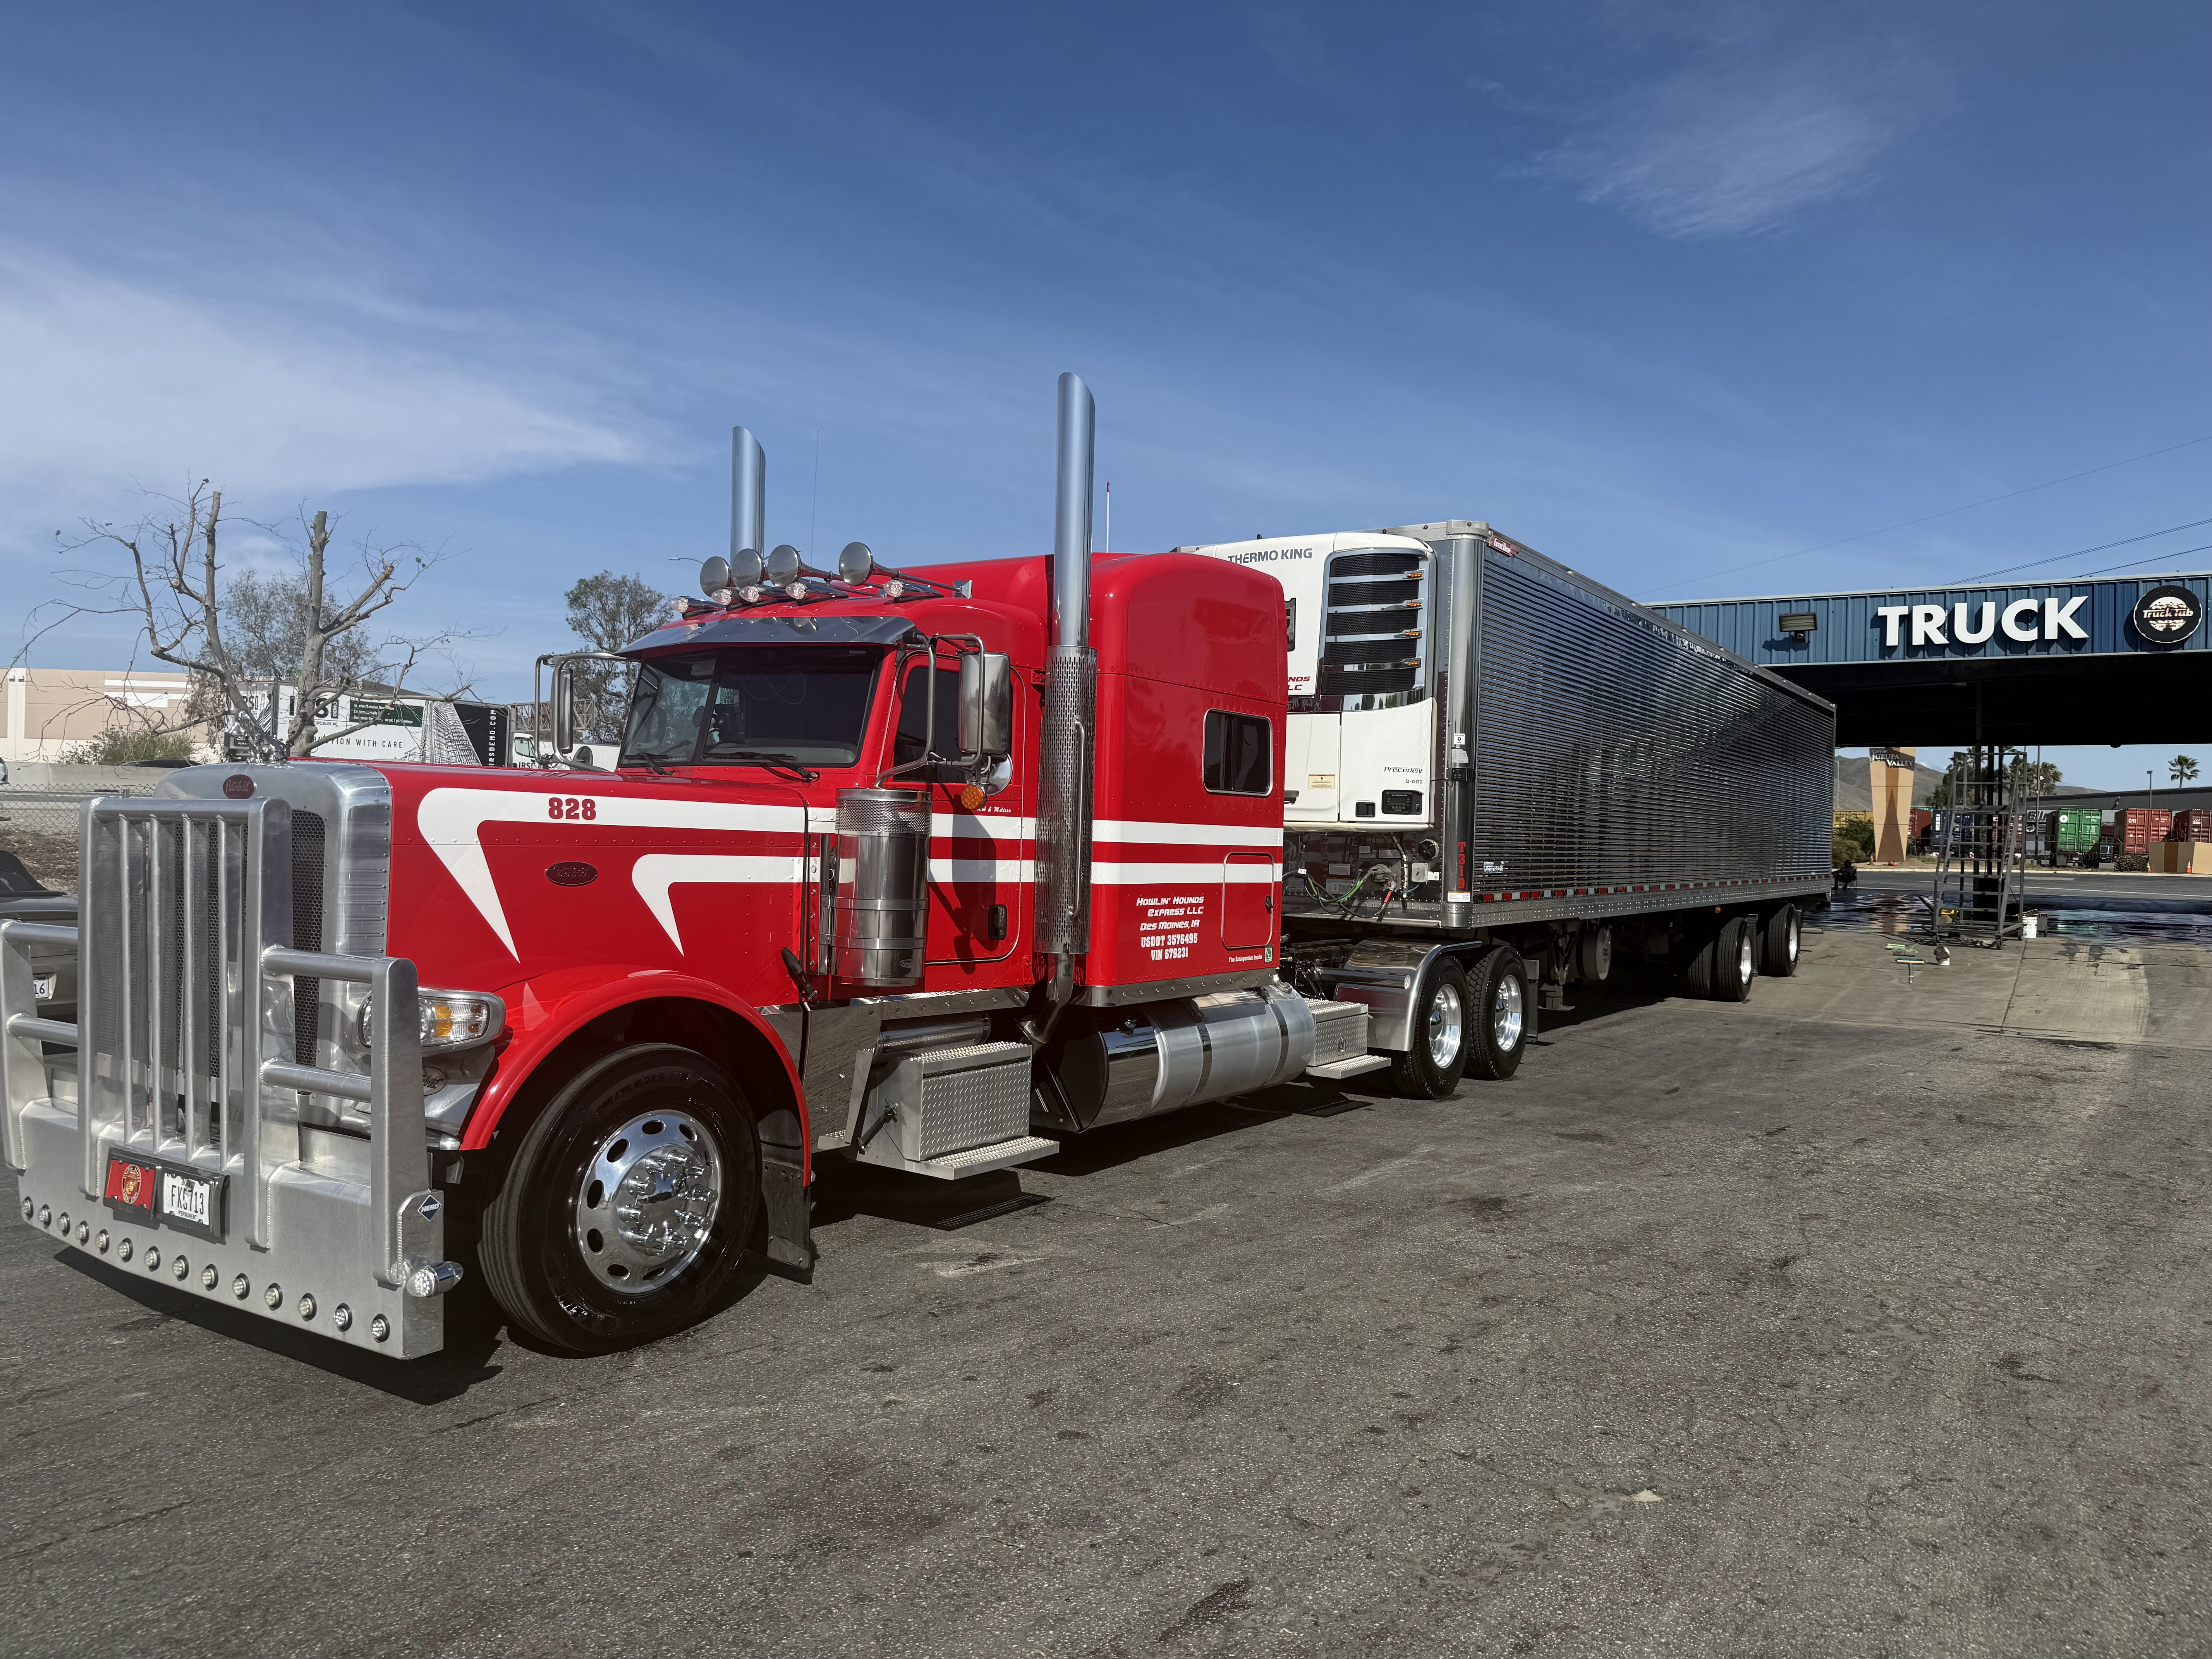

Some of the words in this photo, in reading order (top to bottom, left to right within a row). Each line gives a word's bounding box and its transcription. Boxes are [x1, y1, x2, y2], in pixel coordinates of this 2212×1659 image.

[1228, 550, 1278, 564] THERMO
[1281, 548, 1313, 560] KING
[2143, 607, 2172, 618] Truck
[2171, 608, 2193, 617] Tub
[1877, 596, 2090, 646] TRUCK
[356, 738, 377, 747] WITH
[382, 740, 402, 749] CARE
[225, 779, 251, 793] Peterbilt
[548, 797, 596, 821] 828
[1457, 842, 1467, 890] T319
[1187, 906, 1204, 915] LLC
[1191, 919, 1200, 927] IA
[1141, 935, 1166, 948] USDOT
[1167, 933, 1198, 946] 3576495
[1151, 949, 1163, 961] VIN
[1164, 947, 1188, 960] 679231
[178, 1210, 197, 1220] PERMANENT
[421, 1203, 440, 1213] HERD
